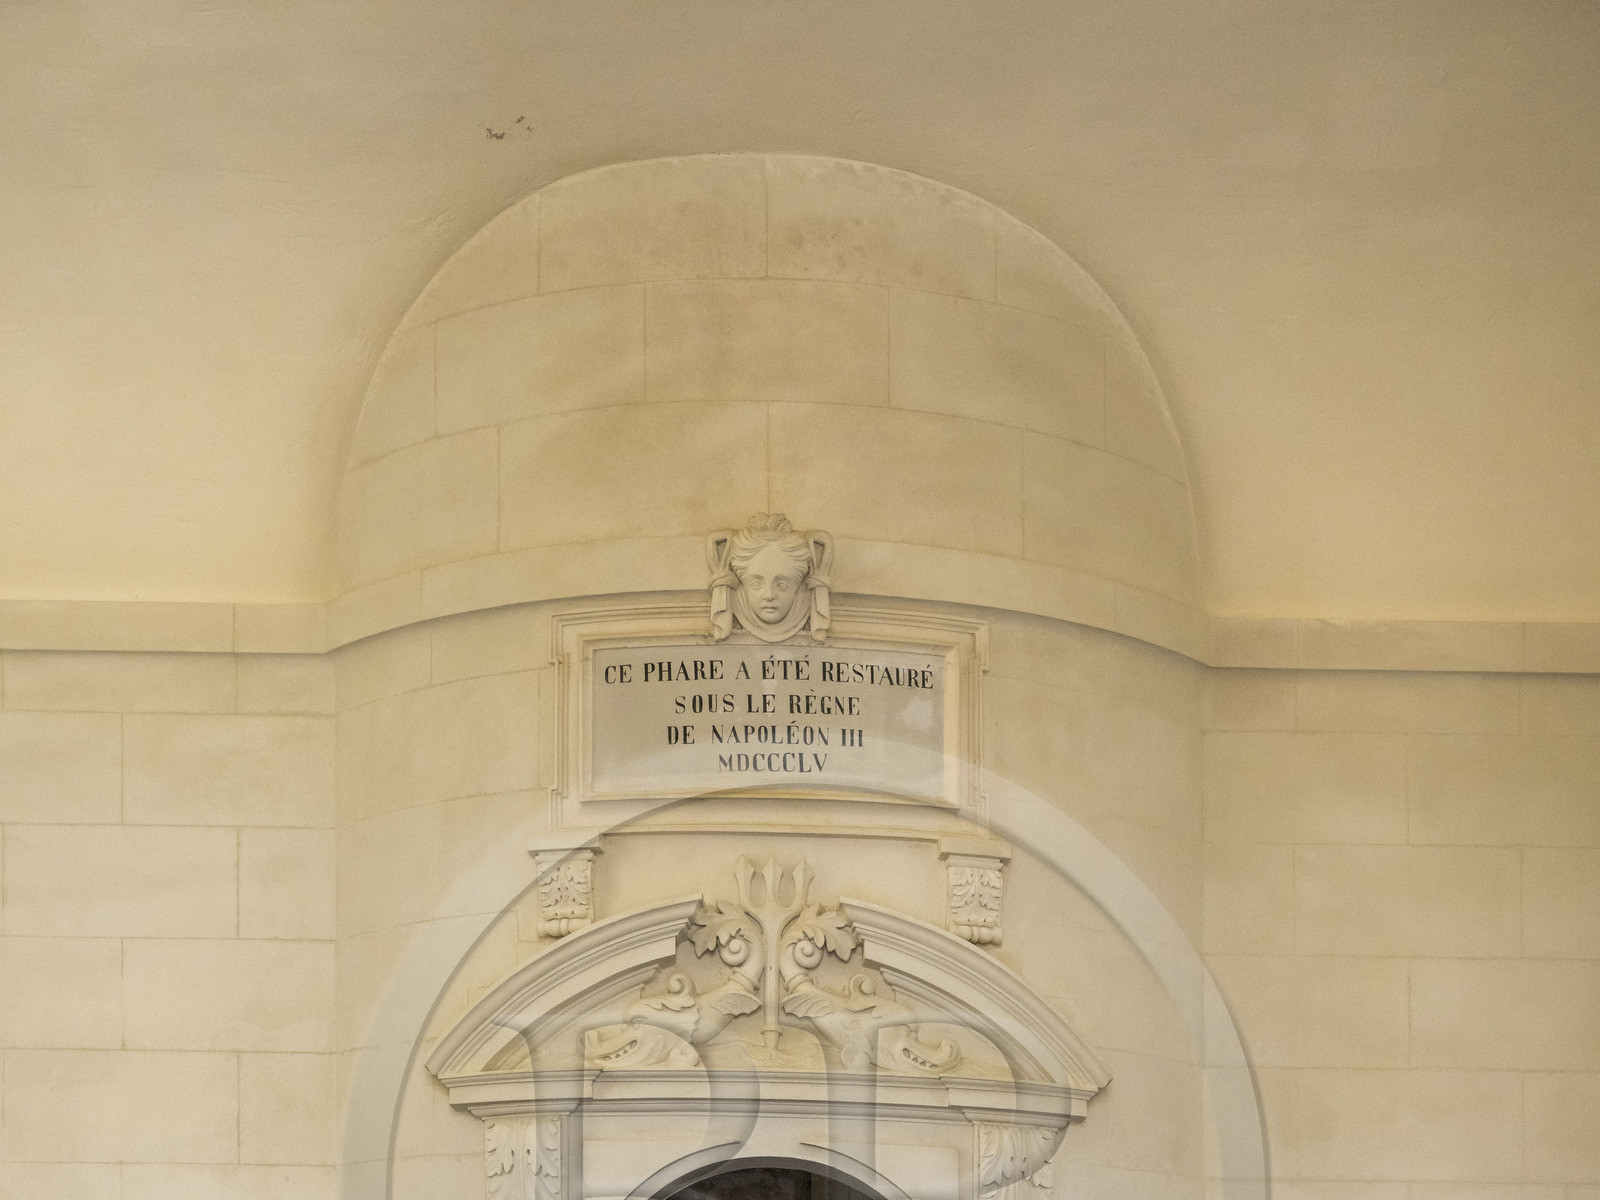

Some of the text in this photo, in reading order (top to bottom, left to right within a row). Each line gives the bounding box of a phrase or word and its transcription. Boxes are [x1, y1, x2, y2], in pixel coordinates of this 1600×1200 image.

[604, 654, 935, 690] CE PHARE A ÉTÉ RESTAURÉ
[674, 688, 861, 716] SOUS LE RÈGNE
[666, 720, 866, 748] DE NAPOLÉON III
[717, 751, 828, 774] MDCCCLV
